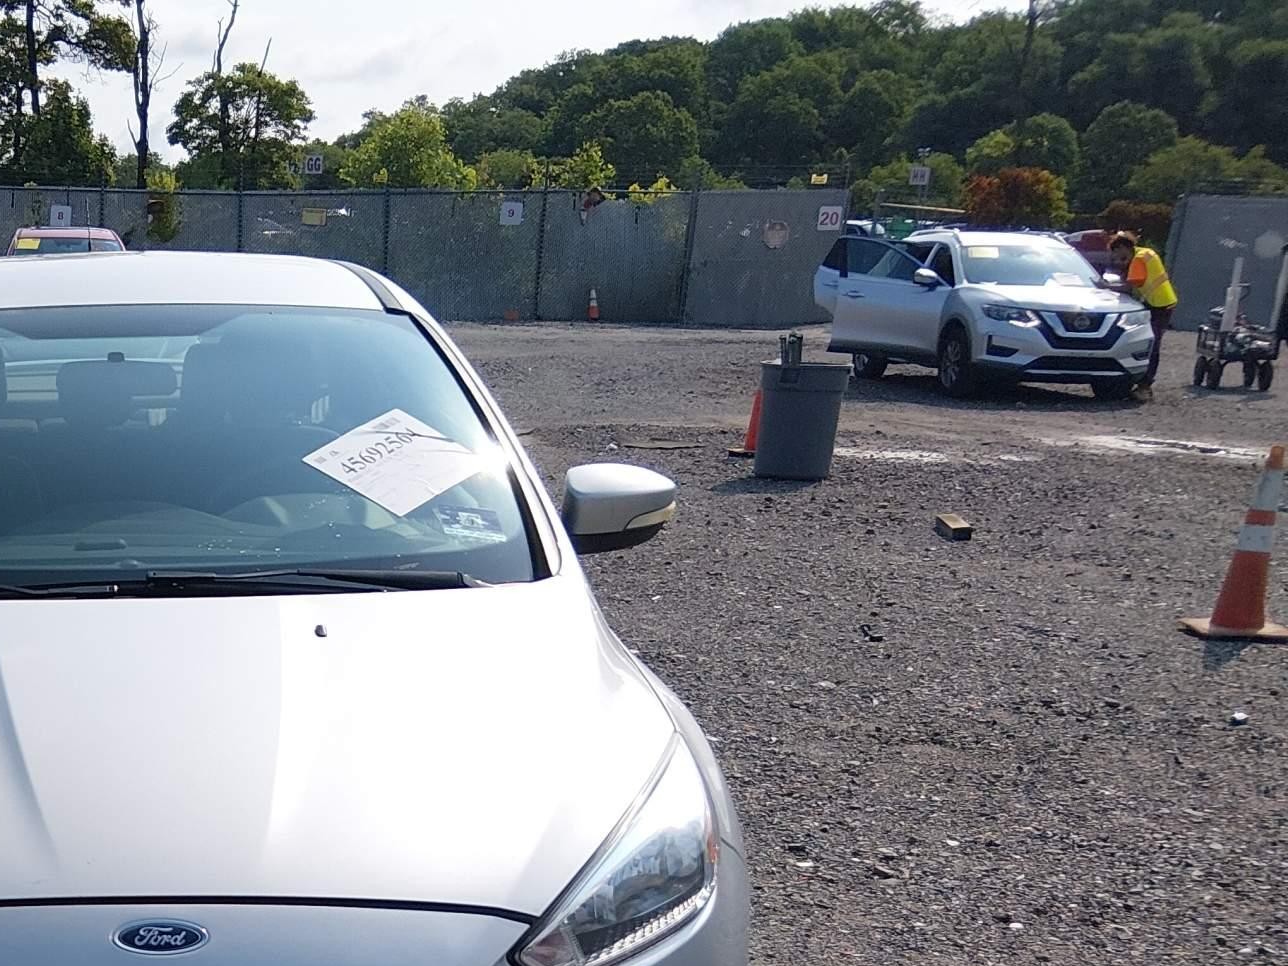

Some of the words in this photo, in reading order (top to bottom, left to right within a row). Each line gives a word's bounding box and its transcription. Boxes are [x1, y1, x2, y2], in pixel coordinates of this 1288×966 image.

[306, 157, 321, 172] GG
[57, 211, 64, 220] 8
[507, 208, 515, 218] 9
[819, 211, 840, 226] 20
[134, 926, 187, 946] Ford
